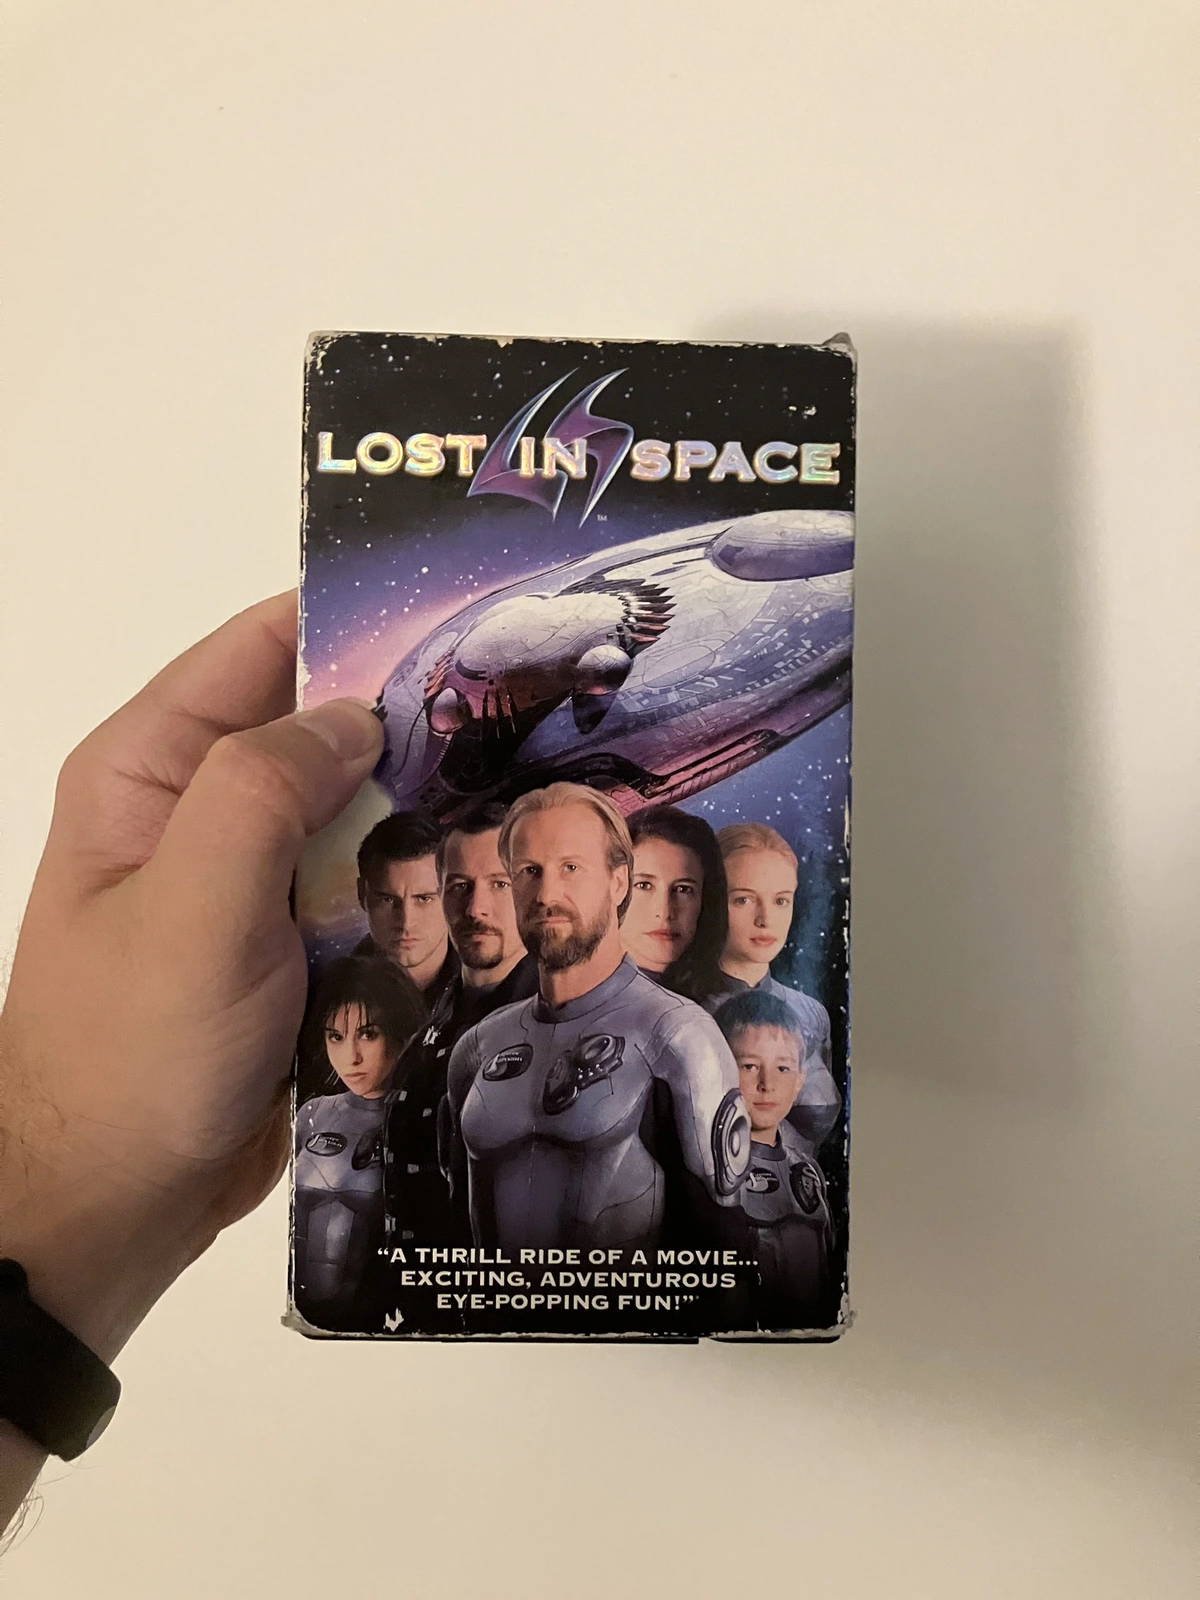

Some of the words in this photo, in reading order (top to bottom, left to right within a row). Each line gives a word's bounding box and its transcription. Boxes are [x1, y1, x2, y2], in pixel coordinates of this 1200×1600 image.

[318, 431, 487, 477] LOST
[519, 436, 588, 479] IN
[630, 438, 841, 485] SPACE
[415, 1248, 512, 1264] THRILL
[520, 1249, 581, 1265] RIDE
[588, 1249, 623, 1266] OF
[631, 1250, 648, 1266] A
[657, 1250, 758, 1266] MOVIE...
[401, 1270, 531, 1289] EXCITING,
[540, 1271, 736, 1288] ADVENTUROUS
[437, 1293, 610, 1311] EYE-POPPING
